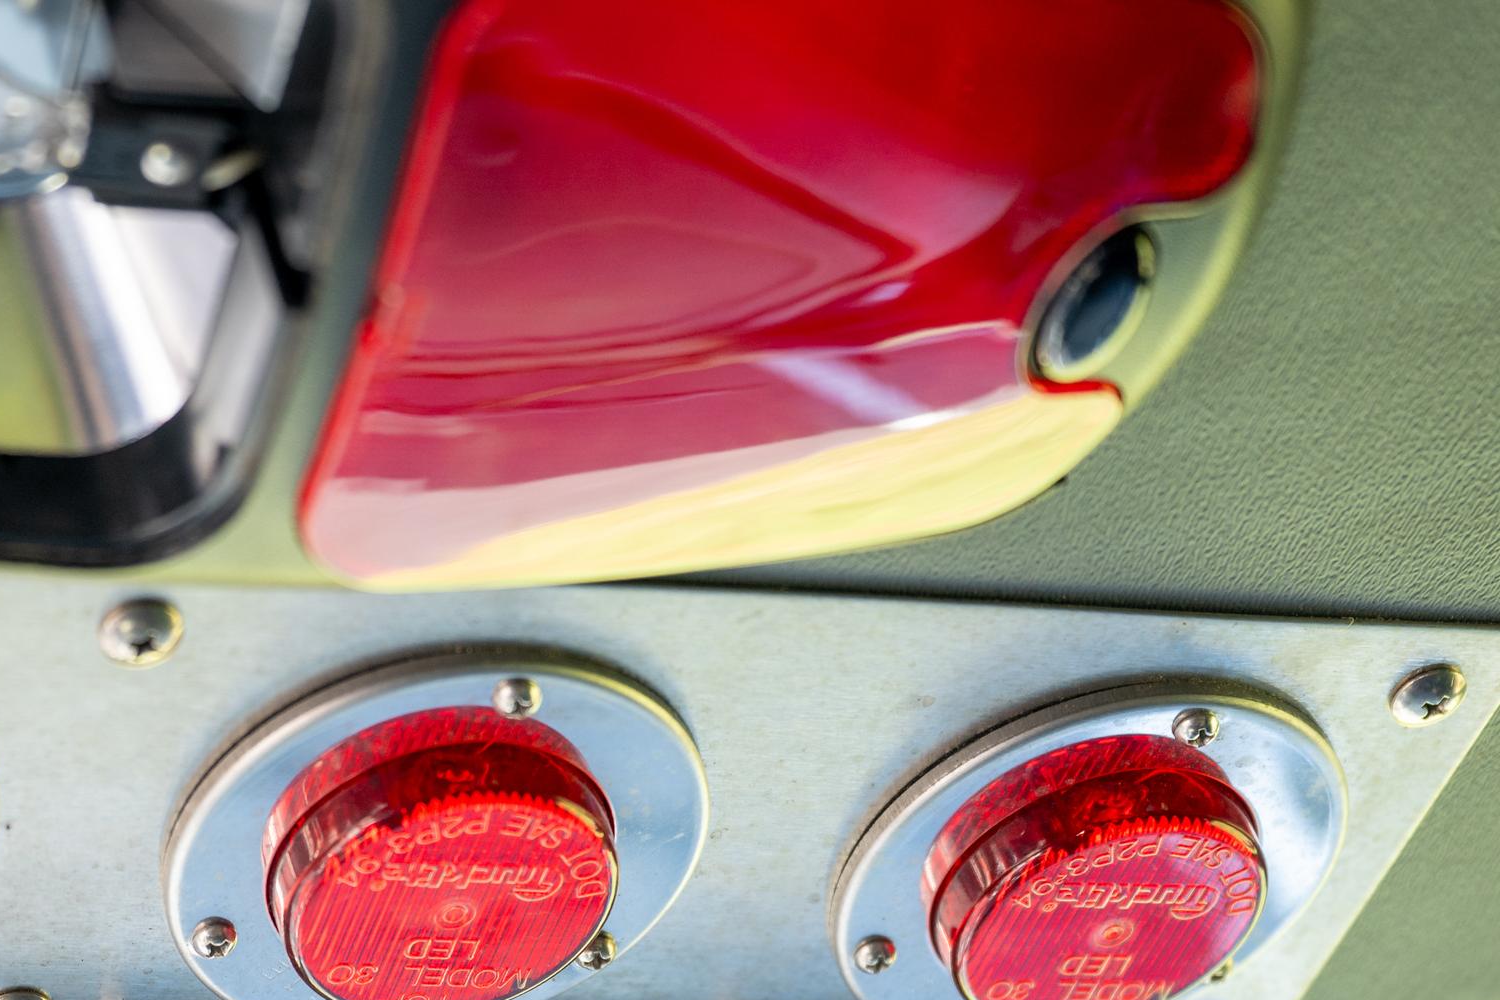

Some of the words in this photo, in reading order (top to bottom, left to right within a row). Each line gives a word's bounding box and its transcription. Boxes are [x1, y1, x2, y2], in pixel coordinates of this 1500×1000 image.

[501, 811, 573, 850] SAE
[1169, 834, 1232, 870] SAE
[559, 847, 607, 900] DOT
[1218, 862, 1258, 918] DOT
[403, 936, 481, 960] LED
[326, 961, 379, 986] 30
[406, 964, 532, 989] MODEL
[1058, 954, 1133, 977] LED
